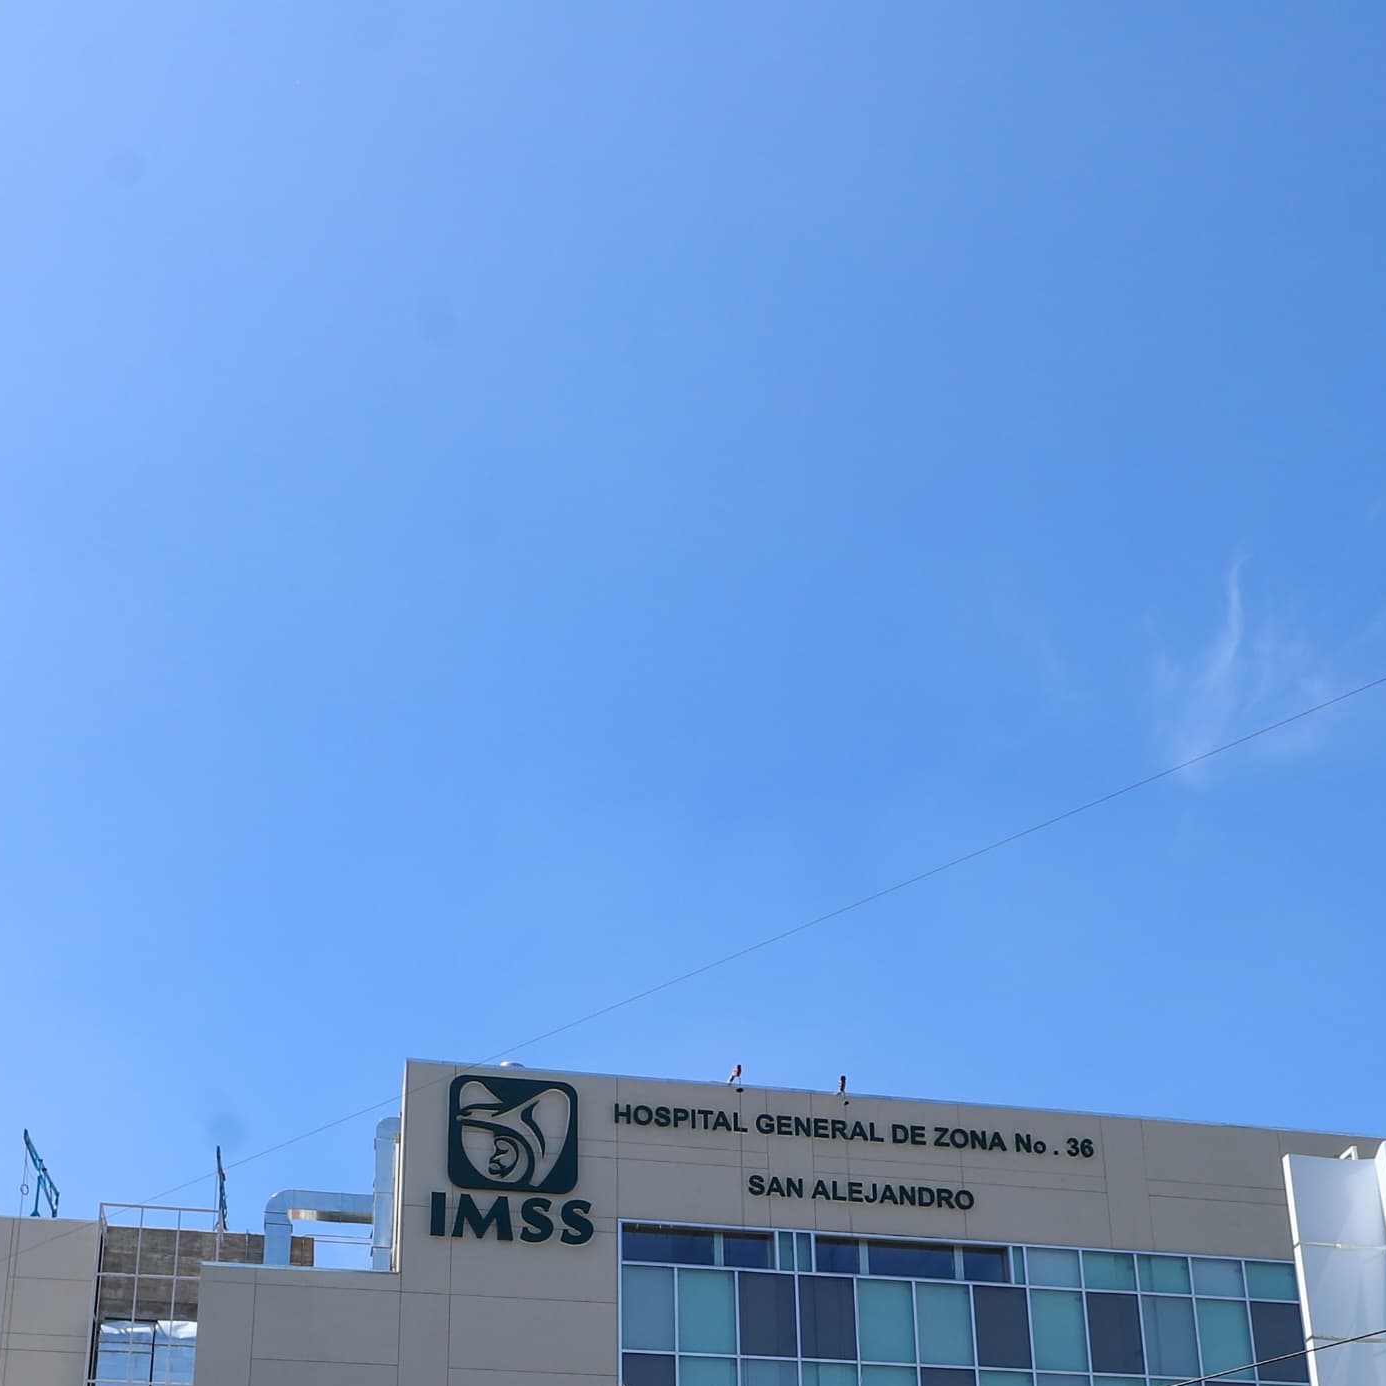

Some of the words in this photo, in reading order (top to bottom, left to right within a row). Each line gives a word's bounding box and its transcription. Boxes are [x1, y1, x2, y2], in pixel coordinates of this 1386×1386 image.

[614, 1103, 748, 1133] HOSPITAL
[755, 1113, 884, 1143] GENERAL
[891, 1123, 926, 1146] DE
[933, 1127, 1007, 1151] ZONA
[1066, 1137, 1094, 1158] 36
[430, 1192, 594, 1245] IMSS
[748, 1175, 803, 1198] SAN
[812, 1179, 974, 1210] ALEJANDRO
